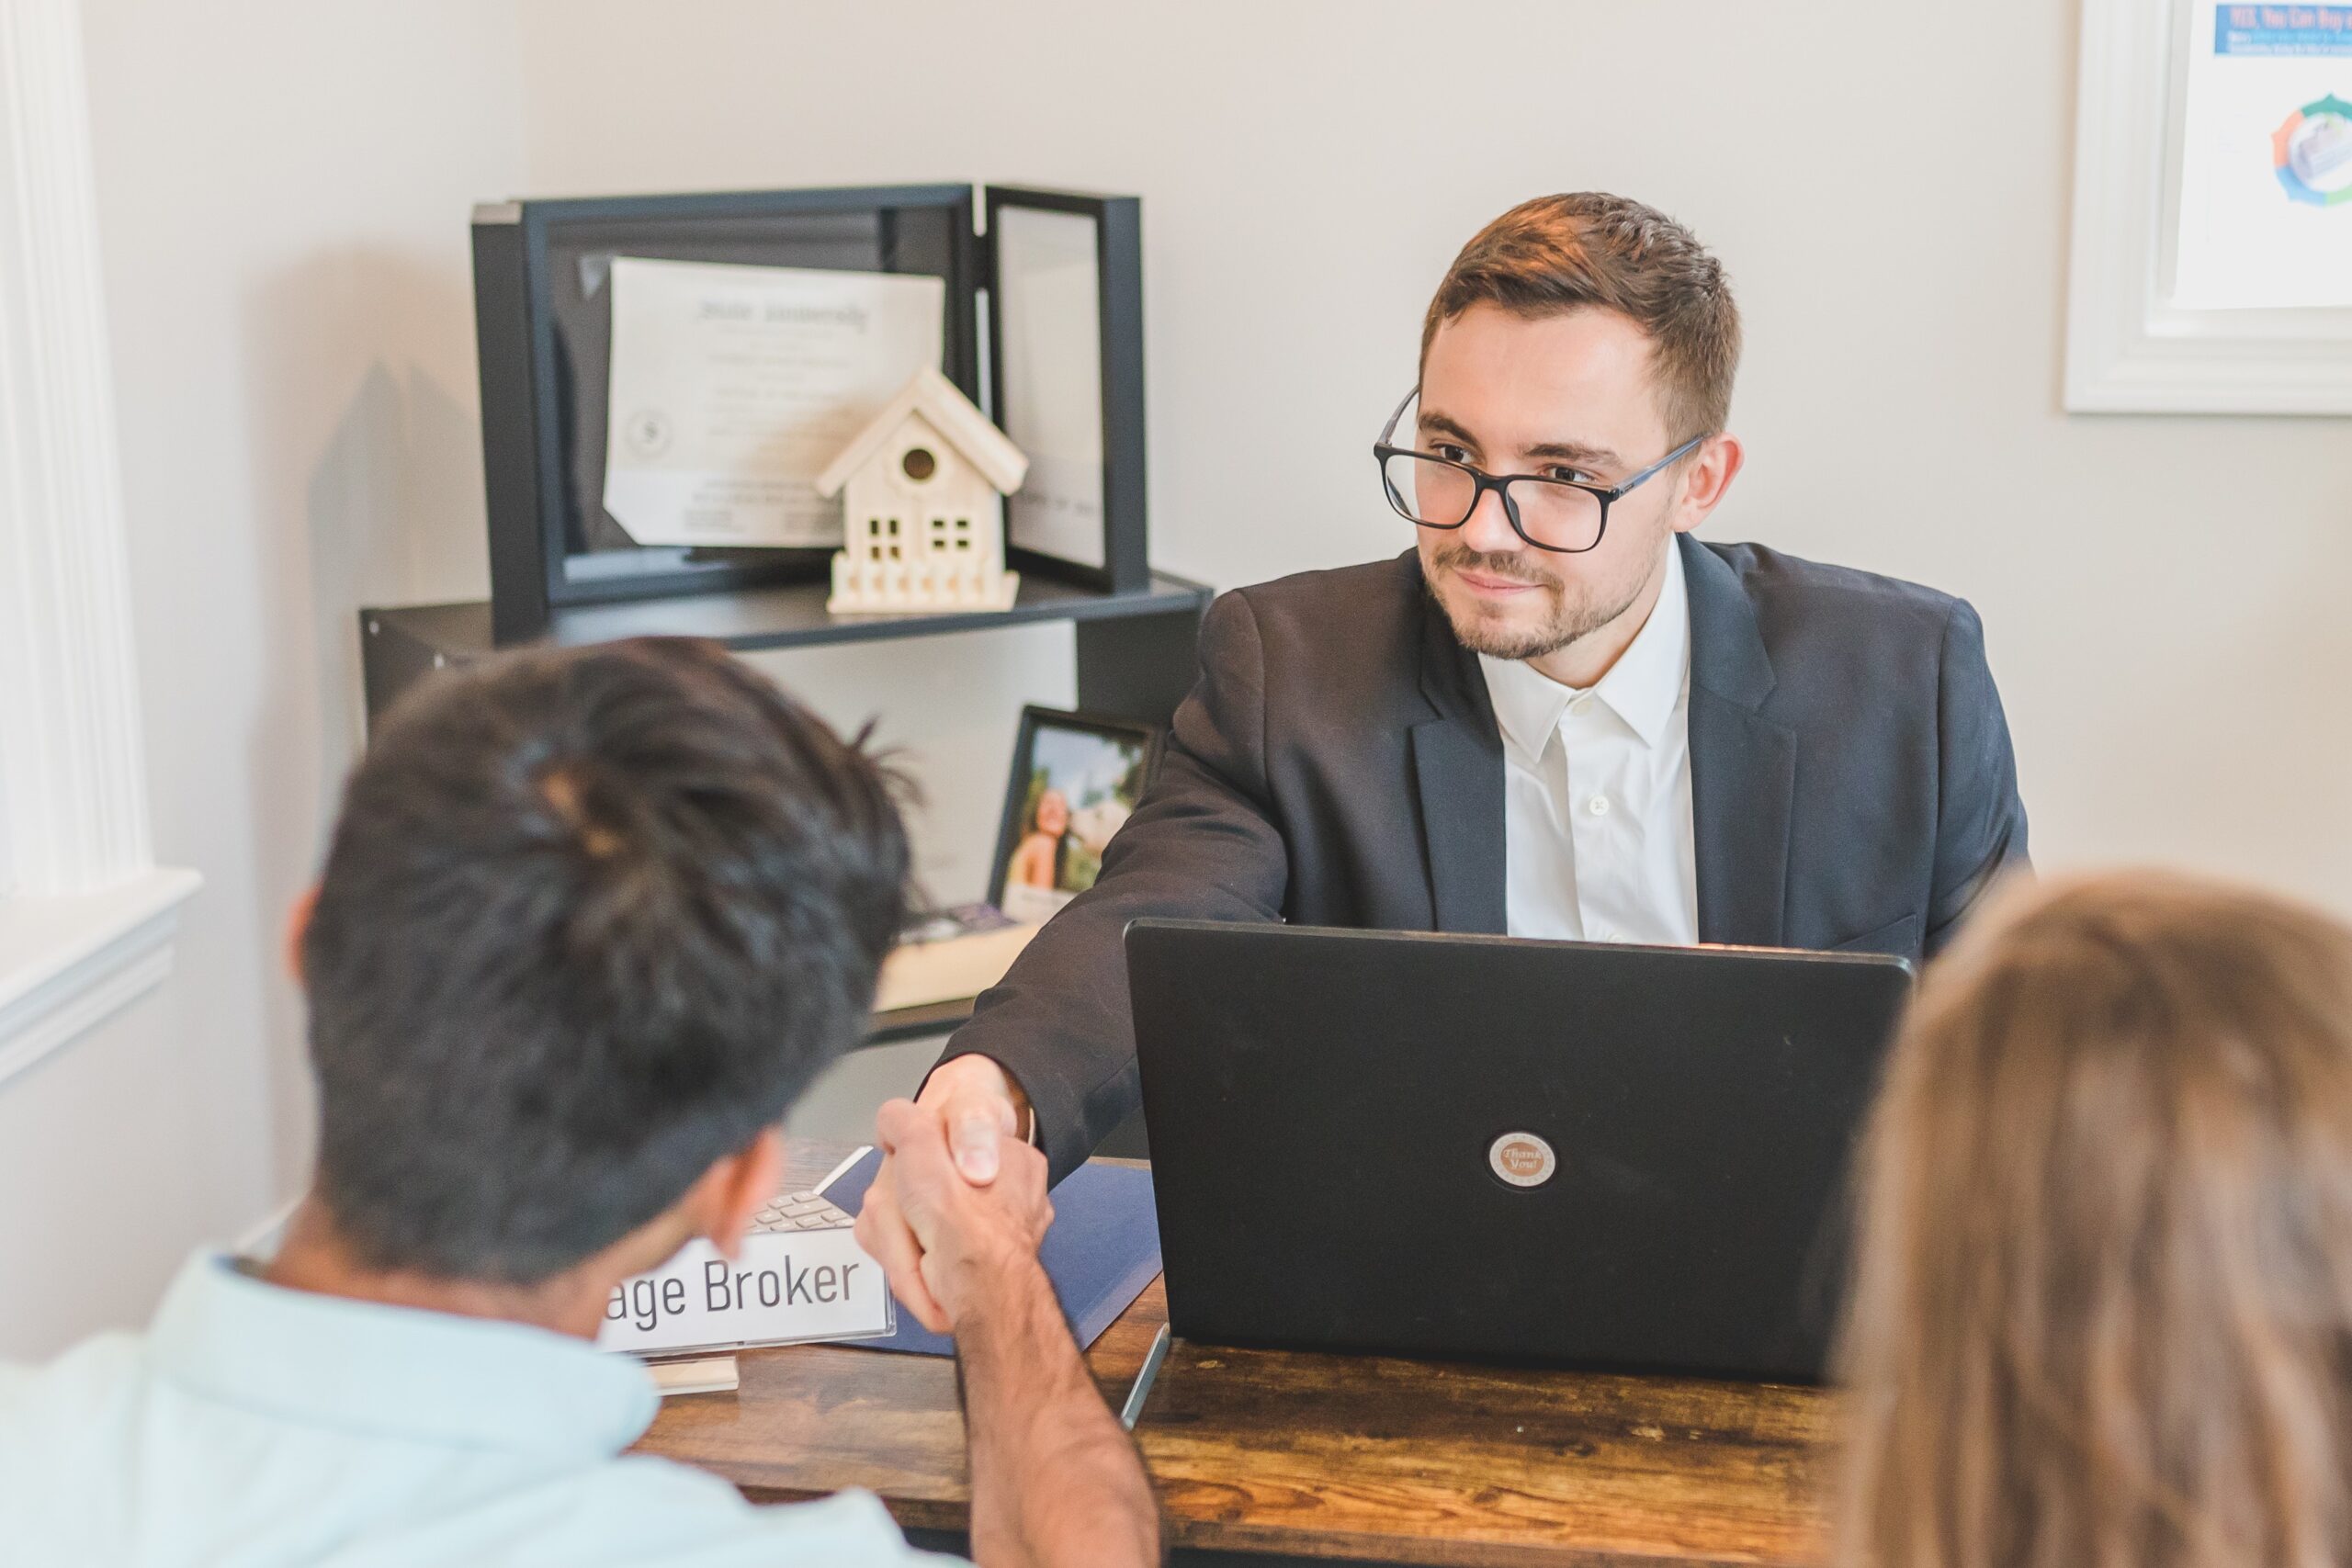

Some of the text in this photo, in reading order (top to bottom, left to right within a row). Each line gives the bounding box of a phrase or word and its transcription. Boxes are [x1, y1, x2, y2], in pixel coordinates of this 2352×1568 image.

[2262, 6, 2287, 28] You
[2289, 7, 2314, 28] Can
[2317, 7, 2343, 33] Buy
[1503, 1147, 1543, 1159] Thank
[704, 1255, 860, 1313] Broker
